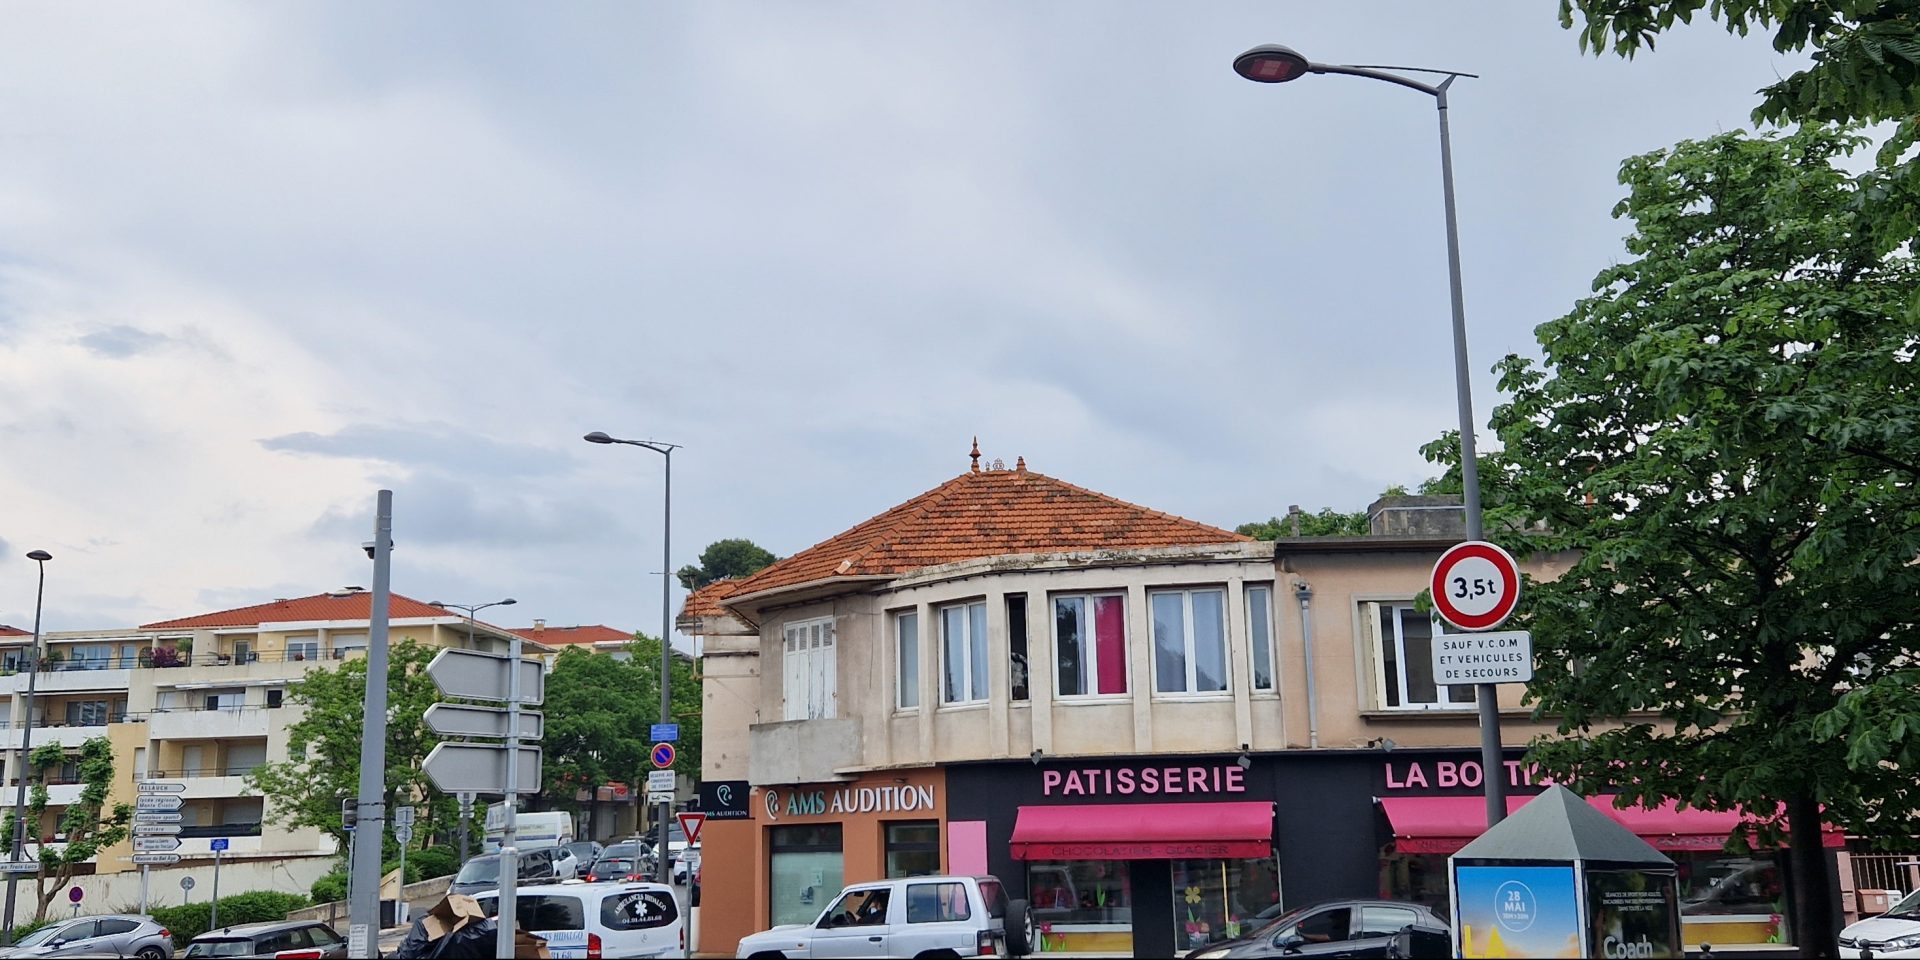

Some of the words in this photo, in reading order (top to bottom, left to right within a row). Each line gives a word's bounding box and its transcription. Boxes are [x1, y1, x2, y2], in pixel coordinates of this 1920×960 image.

[1453, 577, 1496, 600] 3,5t
[1443, 641, 1473, 650] SAUF
[1440, 656, 1452, 665] ET
[1458, 653, 1523, 664] VEHICULES
[1446, 670, 1459, 679] DE
[1465, 668, 1518, 678] SECOURS
[1043, 765, 1246, 796] PATISSERIE
[1385, 761, 1428, 789] LA
[786, 791, 825, 816] AMS
[830, 785, 935, 814] AUDITION
[1051, 846, 1152, 857] CHOCOLATIER
[1166, 845, 1229, 856] GLACIER
[1507, 891, 1521, 901] 28
[644, 893, 667, 912] HIDALGO
[1504, 901, 1525, 912] MAI
[553, 931, 583, 941] HIDALGO
[1603, 934, 1653, 959] Coach
